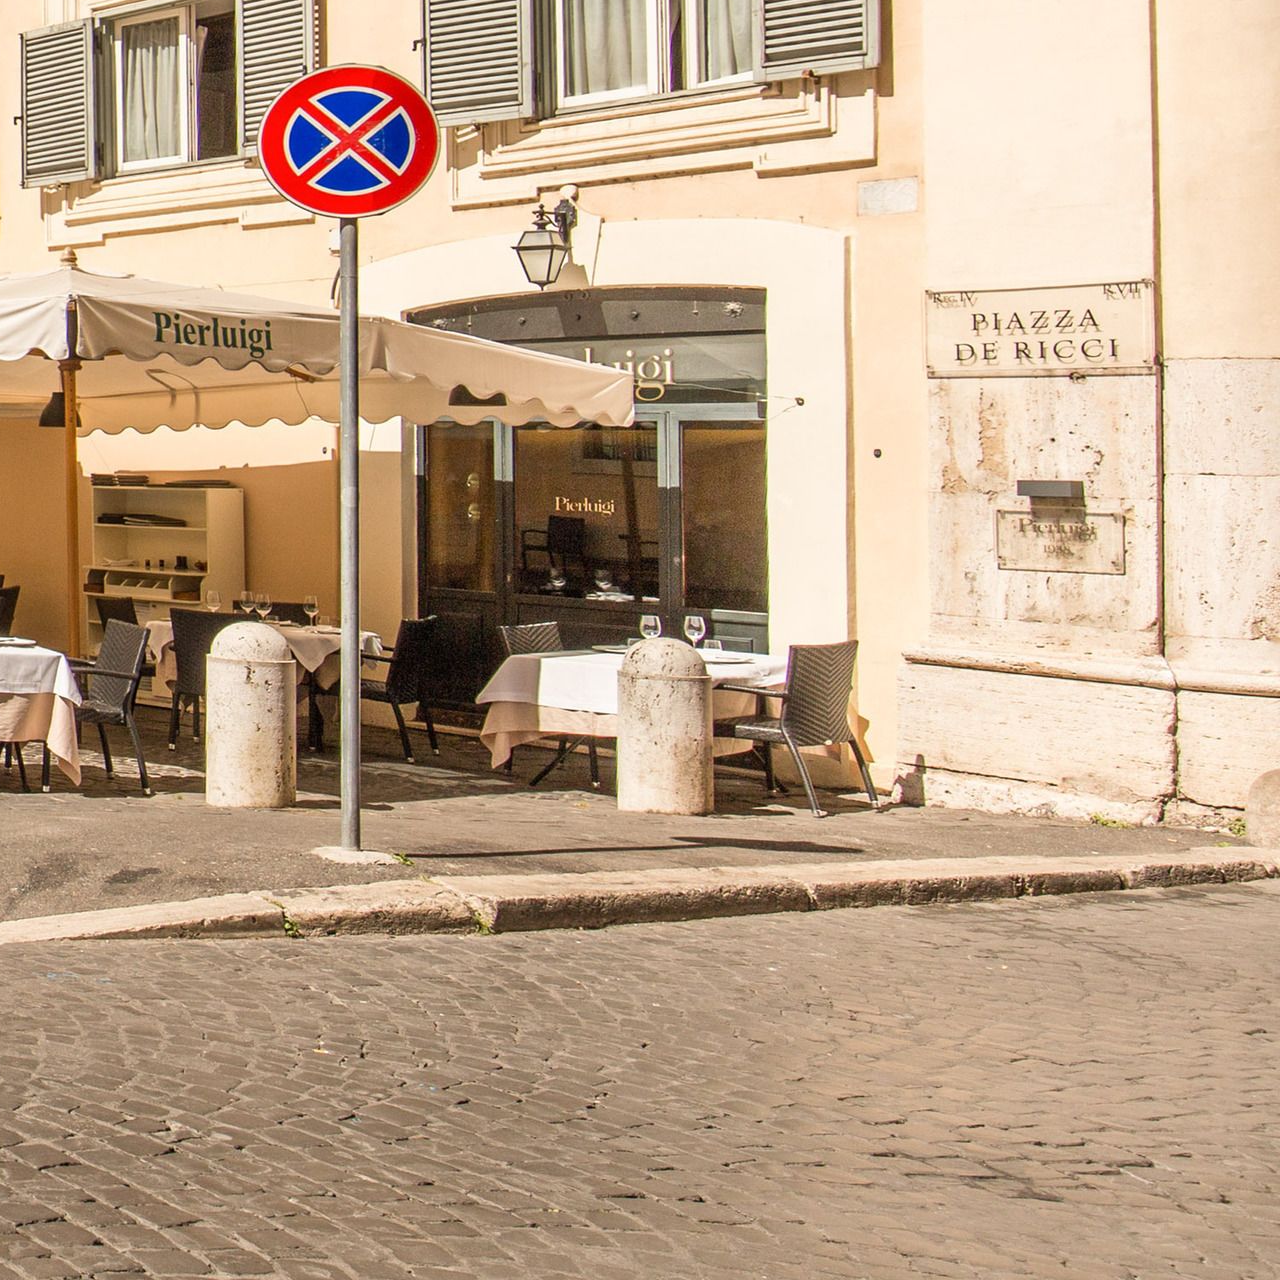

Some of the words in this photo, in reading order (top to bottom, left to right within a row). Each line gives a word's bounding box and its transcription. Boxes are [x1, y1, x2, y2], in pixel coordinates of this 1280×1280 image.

[971, 309, 1099, 331] PIAZZA
[153, 312, 273, 358] Pierluigi
[1014, 339, 1118, 360] RICCI
[555, 496, 615, 513] Pierluigi
